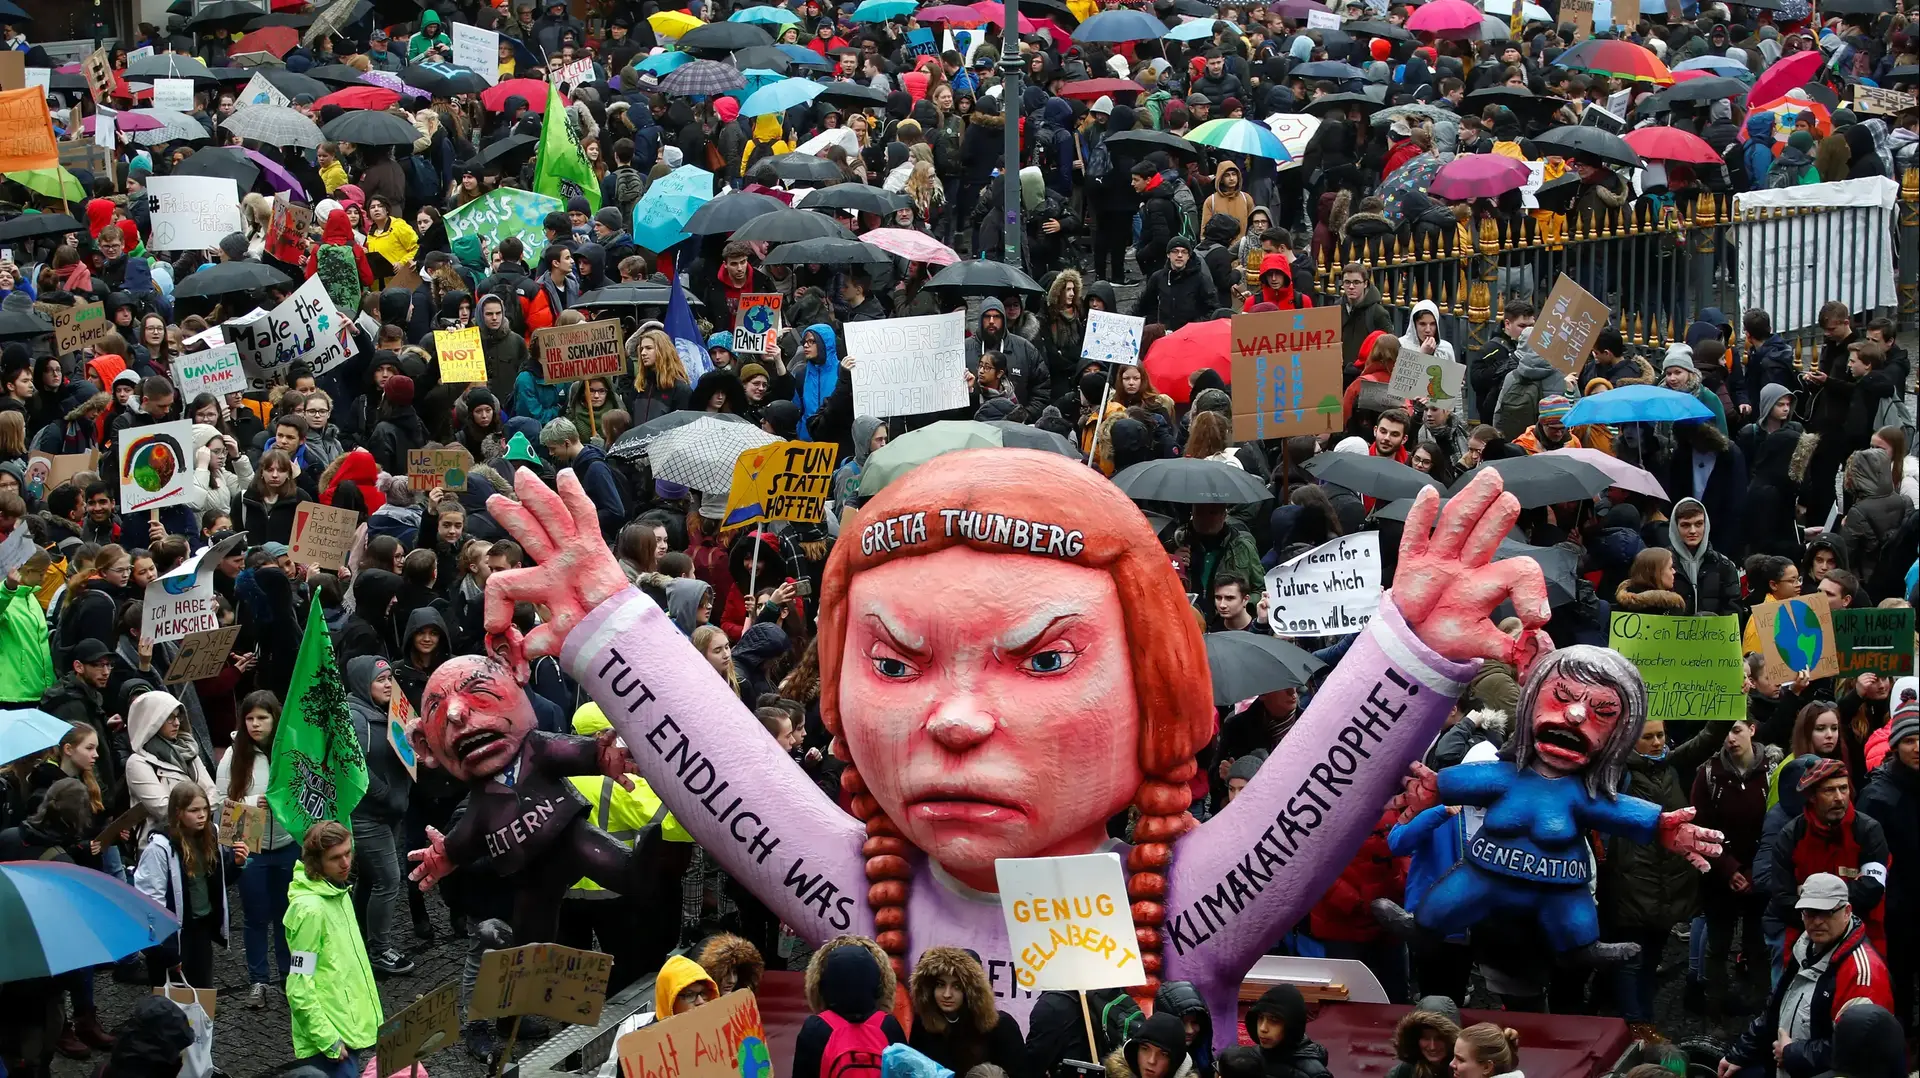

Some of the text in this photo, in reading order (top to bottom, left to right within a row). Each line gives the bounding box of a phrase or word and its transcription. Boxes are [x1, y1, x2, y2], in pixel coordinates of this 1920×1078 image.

[1561, 0, 1593, 12] SAVE SANTA
[660, 180, 684, 192] KLIMA
[149, 192, 233, 224] #Fridays for
[449, 194, 513, 240] Parents
[200, 213, 234, 232] Future
[763, 296, 780, 310] NO
[55, 307, 103, 328] GO GREEN
[71, 323, 82, 332] OR
[229, 294, 323, 351] Make the
[1537, 294, 1571, 349] WAS SOLL
[1558, 316, 1577, 342] DER
[61, 323, 105, 351] GO HOME!
[435, 329, 479, 341] SYSTEM
[542, 334, 557, 347] WIR
[590, 325, 615, 342] SCHULE?
[735, 328, 766, 352] PLANET
[850, 323, 940, 355] ÄNDERE
[1237, 329, 1335, 357] WARUM?
[441, 349, 476, 361] NOT
[546, 340, 619, 363] IHR SCHWÄNZT
[183, 352, 239, 379] UMWELT
[203, 370, 233, 384] BANK
[441, 360, 483, 370] CLIMATE
[547, 354, 622, 379] VERANTWORTUNG!
[855, 349, 965, 386] DANN ÄNDERT
[1398, 359, 1425, 372] DACHTEN
[1398, 368, 1412, 378] AUCH
[1273, 365, 1286, 423] OHNE
[1393, 382, 1412, 392] ZEIT!
[856, 390, 895, 418] SICH
[410, 451, 431, 466] We
[417, 465, 435, 474] have
[785, 448, 832, 474] TUN
[409, 474, 443, 489] TIME
[768, 473, 831, 495] STATT
[312, 506, 324, 521] Es
[328, 509, 338, 523] ist
[861, 508, 1085, 558] GRETA THUNBERG
[307, 548, 316, 557] zu
[1308, 540, 1371, 564] learn for a
[1276, 568, 1365, 598] future which
[152, 599, 206, 620] ICH HABE
[1273, 605, 1372, 632] Soon will be go
[1759, 595, 1824, 628] WE DO
[1819, 612, 1833, 625] NOT
[155, 614, 215, 639] MENSCHEN
[1653, 627, 1671, 640] ein
[1672, 619, 1726, 644] Teufelskreis,
[1729, 622, 1741, 643] de
[1836, 612, 1906, 633] WIR HABEN
[200, 629, 237, 650] SAVE
[1853, 636, 1893, 647] KEINEN
[203, 649, 224, 660] THE
[1681, 654, 1713, 668] werden
[1717, 658, 1740, 668] muss
[187, 661, 226, 678] PLANET
[1768, 654, 1839, 680] HAVE TIME
[1645, 676, 1728, 693] quent nachhaltige
[597, 648, 855, 931] TUT ENDLICH WAS
[1166, 667, 1420, 956] KLIMAKATASTROPHE!
[485, 795, 565, 859] ELTERN-
[1471, 837, 1587, 879] GENERATION
[1013, 893, 1115, 923] GENUG
[500, 949, 525, 966] DIE
[1015, 923, 1137, 987] GELABERT
[404, 988, 454, 1029] RETTET
[419, 999, 458, 1036] JETZT
[695, 1021, 739, 1069] Auf!
